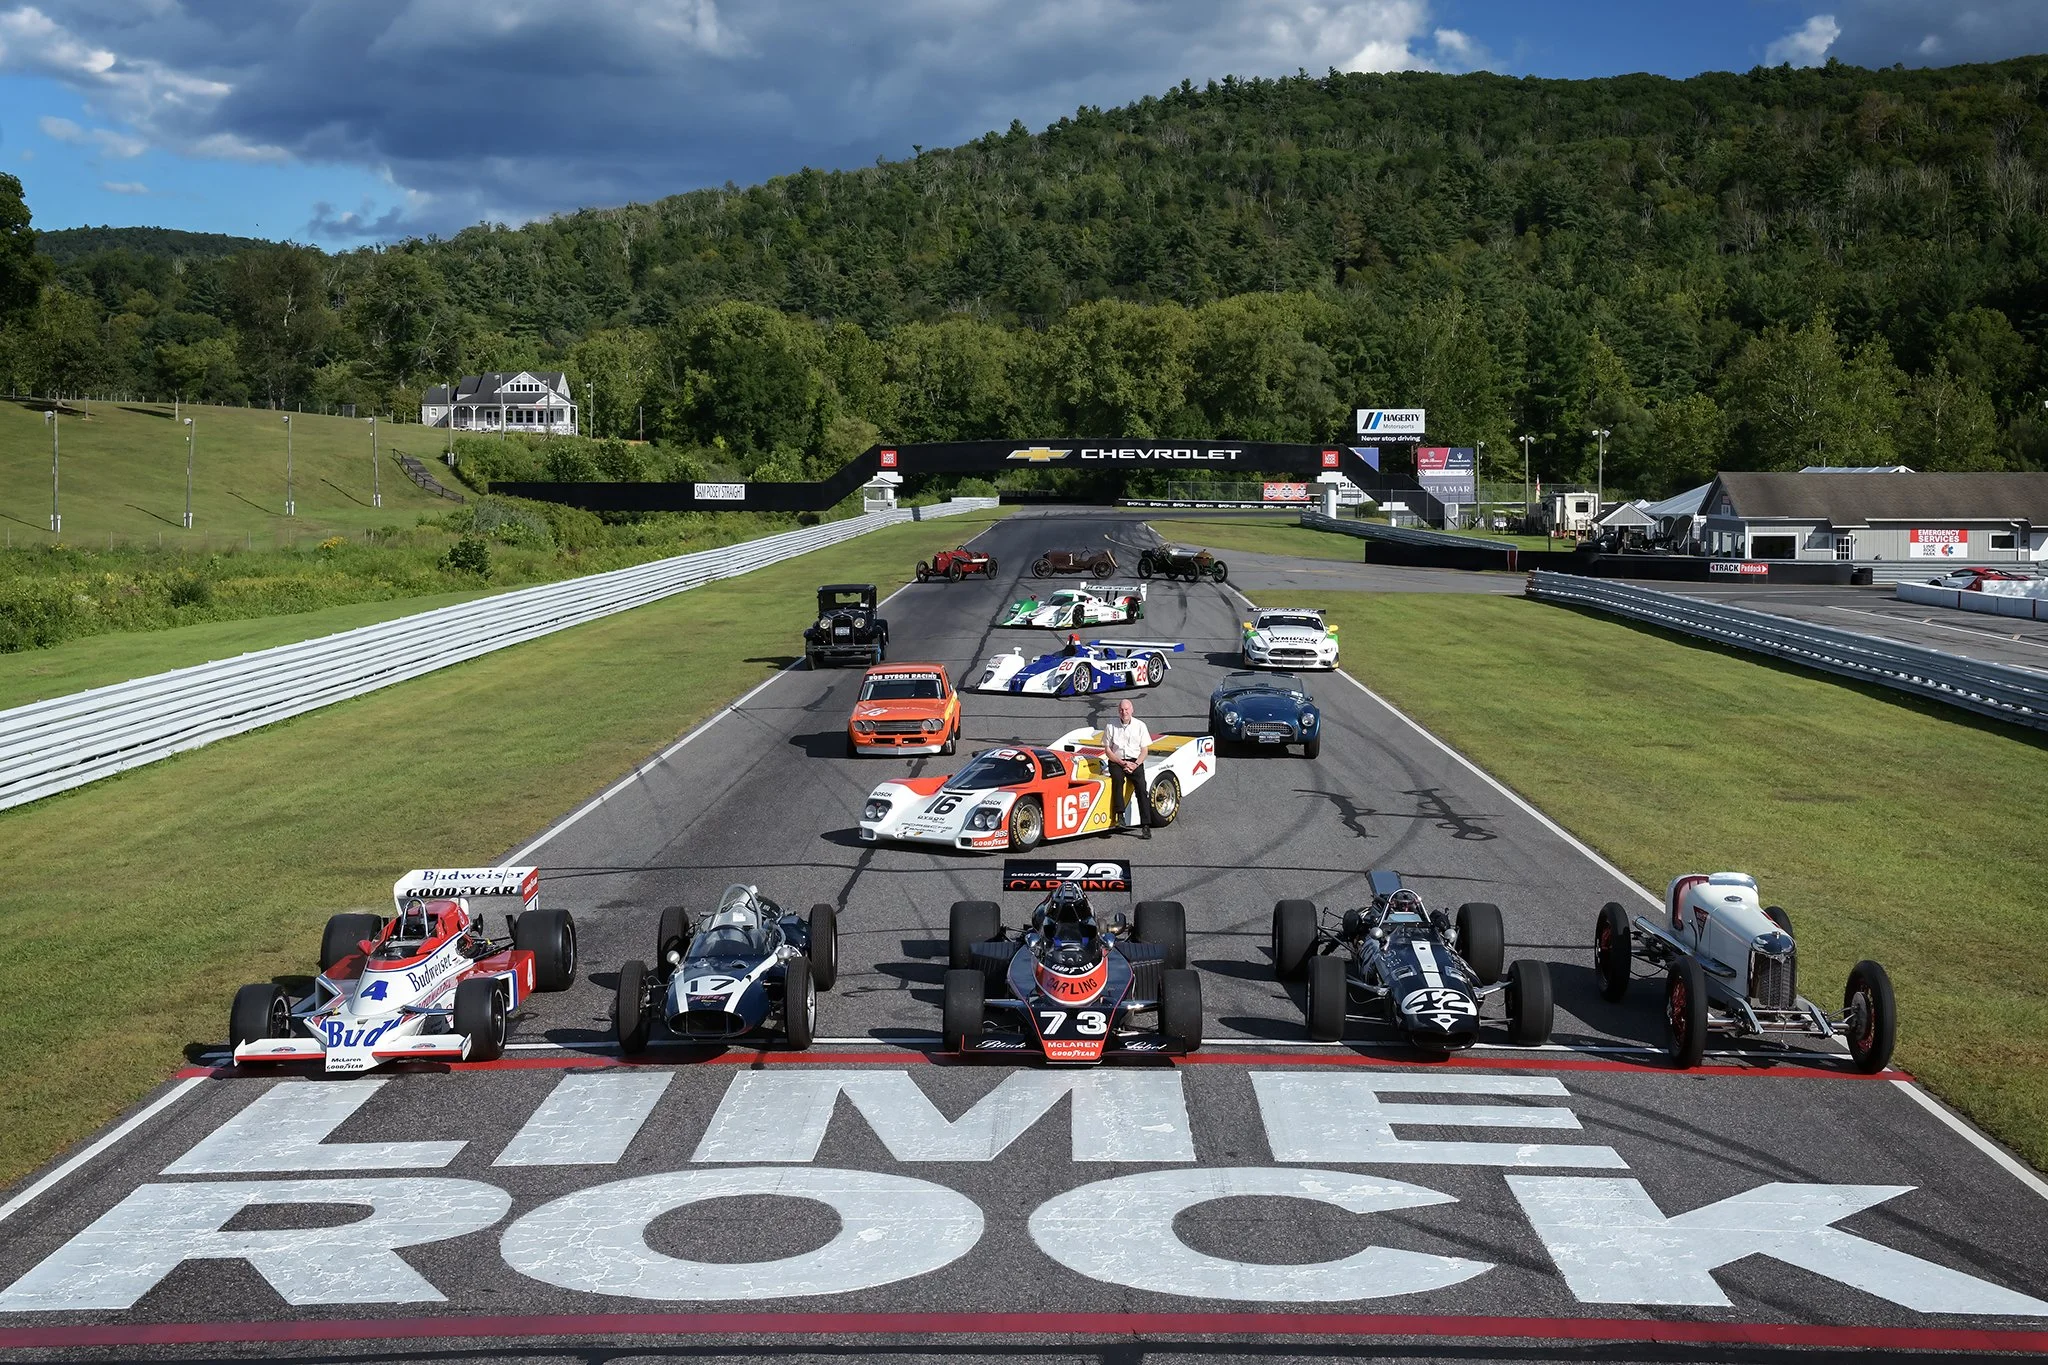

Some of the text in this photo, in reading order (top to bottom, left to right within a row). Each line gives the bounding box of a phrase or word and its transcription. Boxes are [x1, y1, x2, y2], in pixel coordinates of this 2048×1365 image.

[1397, 435, 1421, 443] driving
[1081, 449, 1242, 460] CHEVROLET
[696, 485, 745, 499] SAM POSEY STRAIGHT
[1716, 564, 1739, 572] TRACK
[1741, 564, 1762, 572] Paddock
[1059, 661, 1074, 671] 20
[911, 672, 937, 680] RACING
[923, 795, 963, 815] 16
[1056, 795, 1078, 830] 16
[973, 838, 1009, 848] GOODYEAR
[422, 869, 525, 881] Budweiser
[1056, 862, 1124, 880] 73
[1010, 880, 1126, 890] CARING
[406, 953, 452, 993] Budweiser
[527, 958, 534, 991] 4
[360, 980, 389, 1001] 4
[690, 979, 735, 992] 17
[1047, 977, 1098, 995] CARLING
[1404, 990, 1472, 1014] 42
[1040, 1011, 1107, 1035] 73
[327, 1018, 394, 1048] Bud
[1051, 1050, 1096, 1058] GOODYEAR
[160, 1070, 1630, 1174] LIME
[0, 1166, 2048, 1316] ROCK
